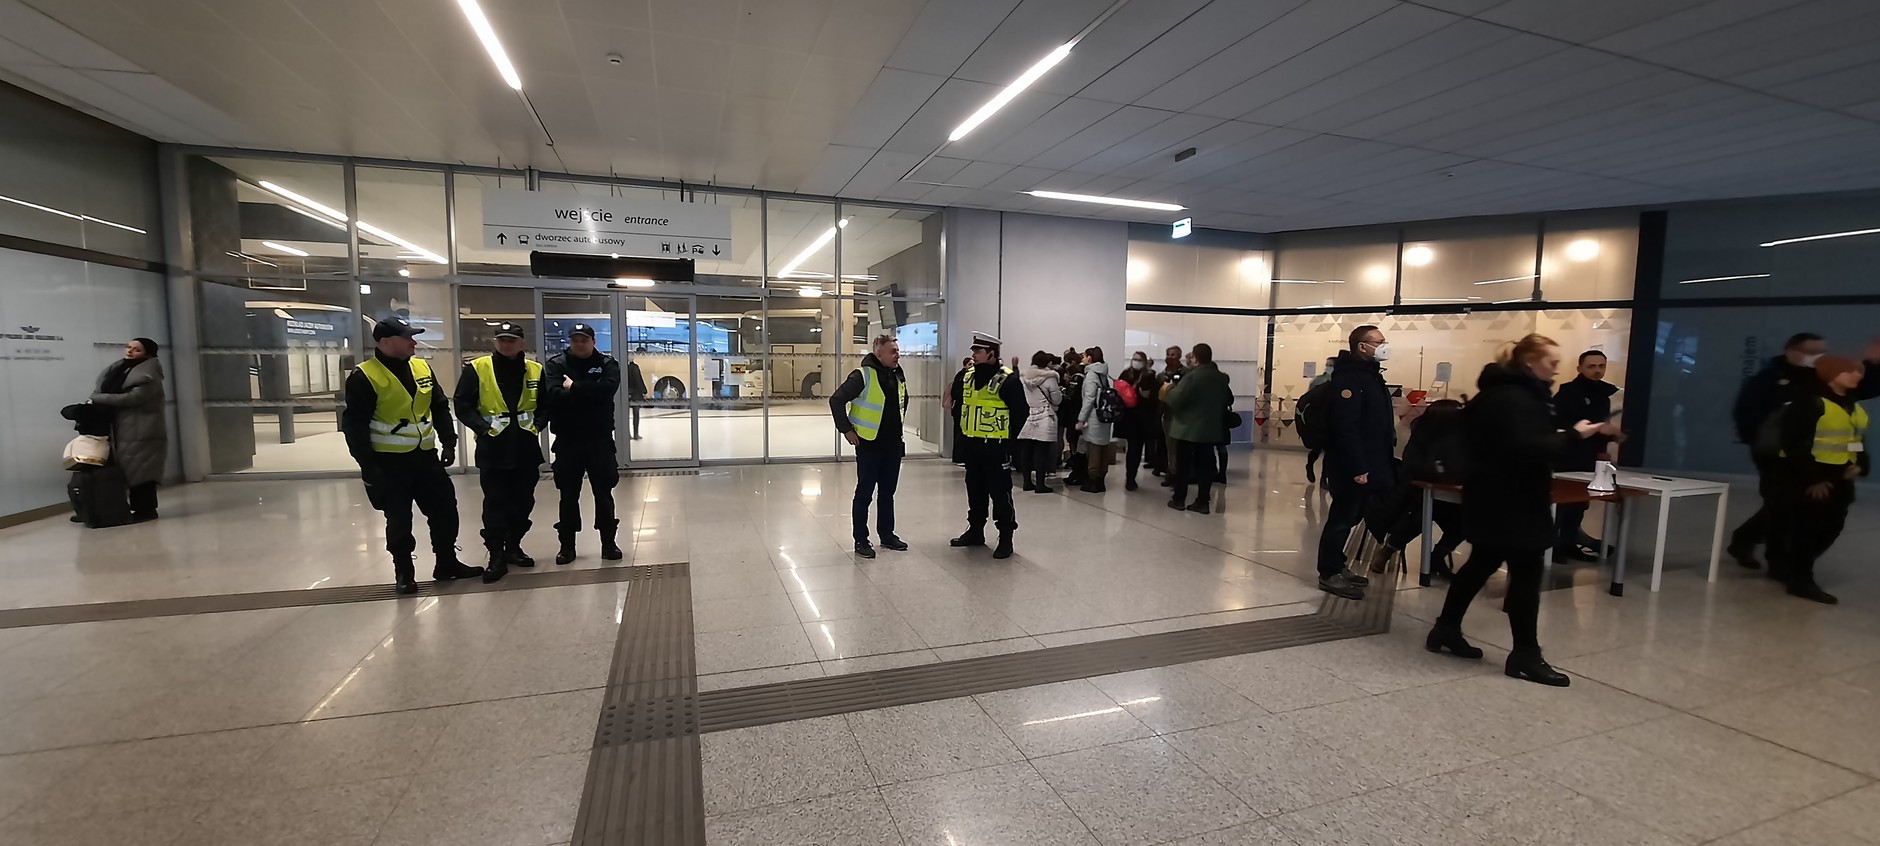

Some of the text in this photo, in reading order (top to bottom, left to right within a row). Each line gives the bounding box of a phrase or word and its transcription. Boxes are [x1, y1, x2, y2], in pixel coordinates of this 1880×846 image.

[554, 207, 669, 226] wejście entrance
[535, 233, 626, 247] dworzec autobusowy
